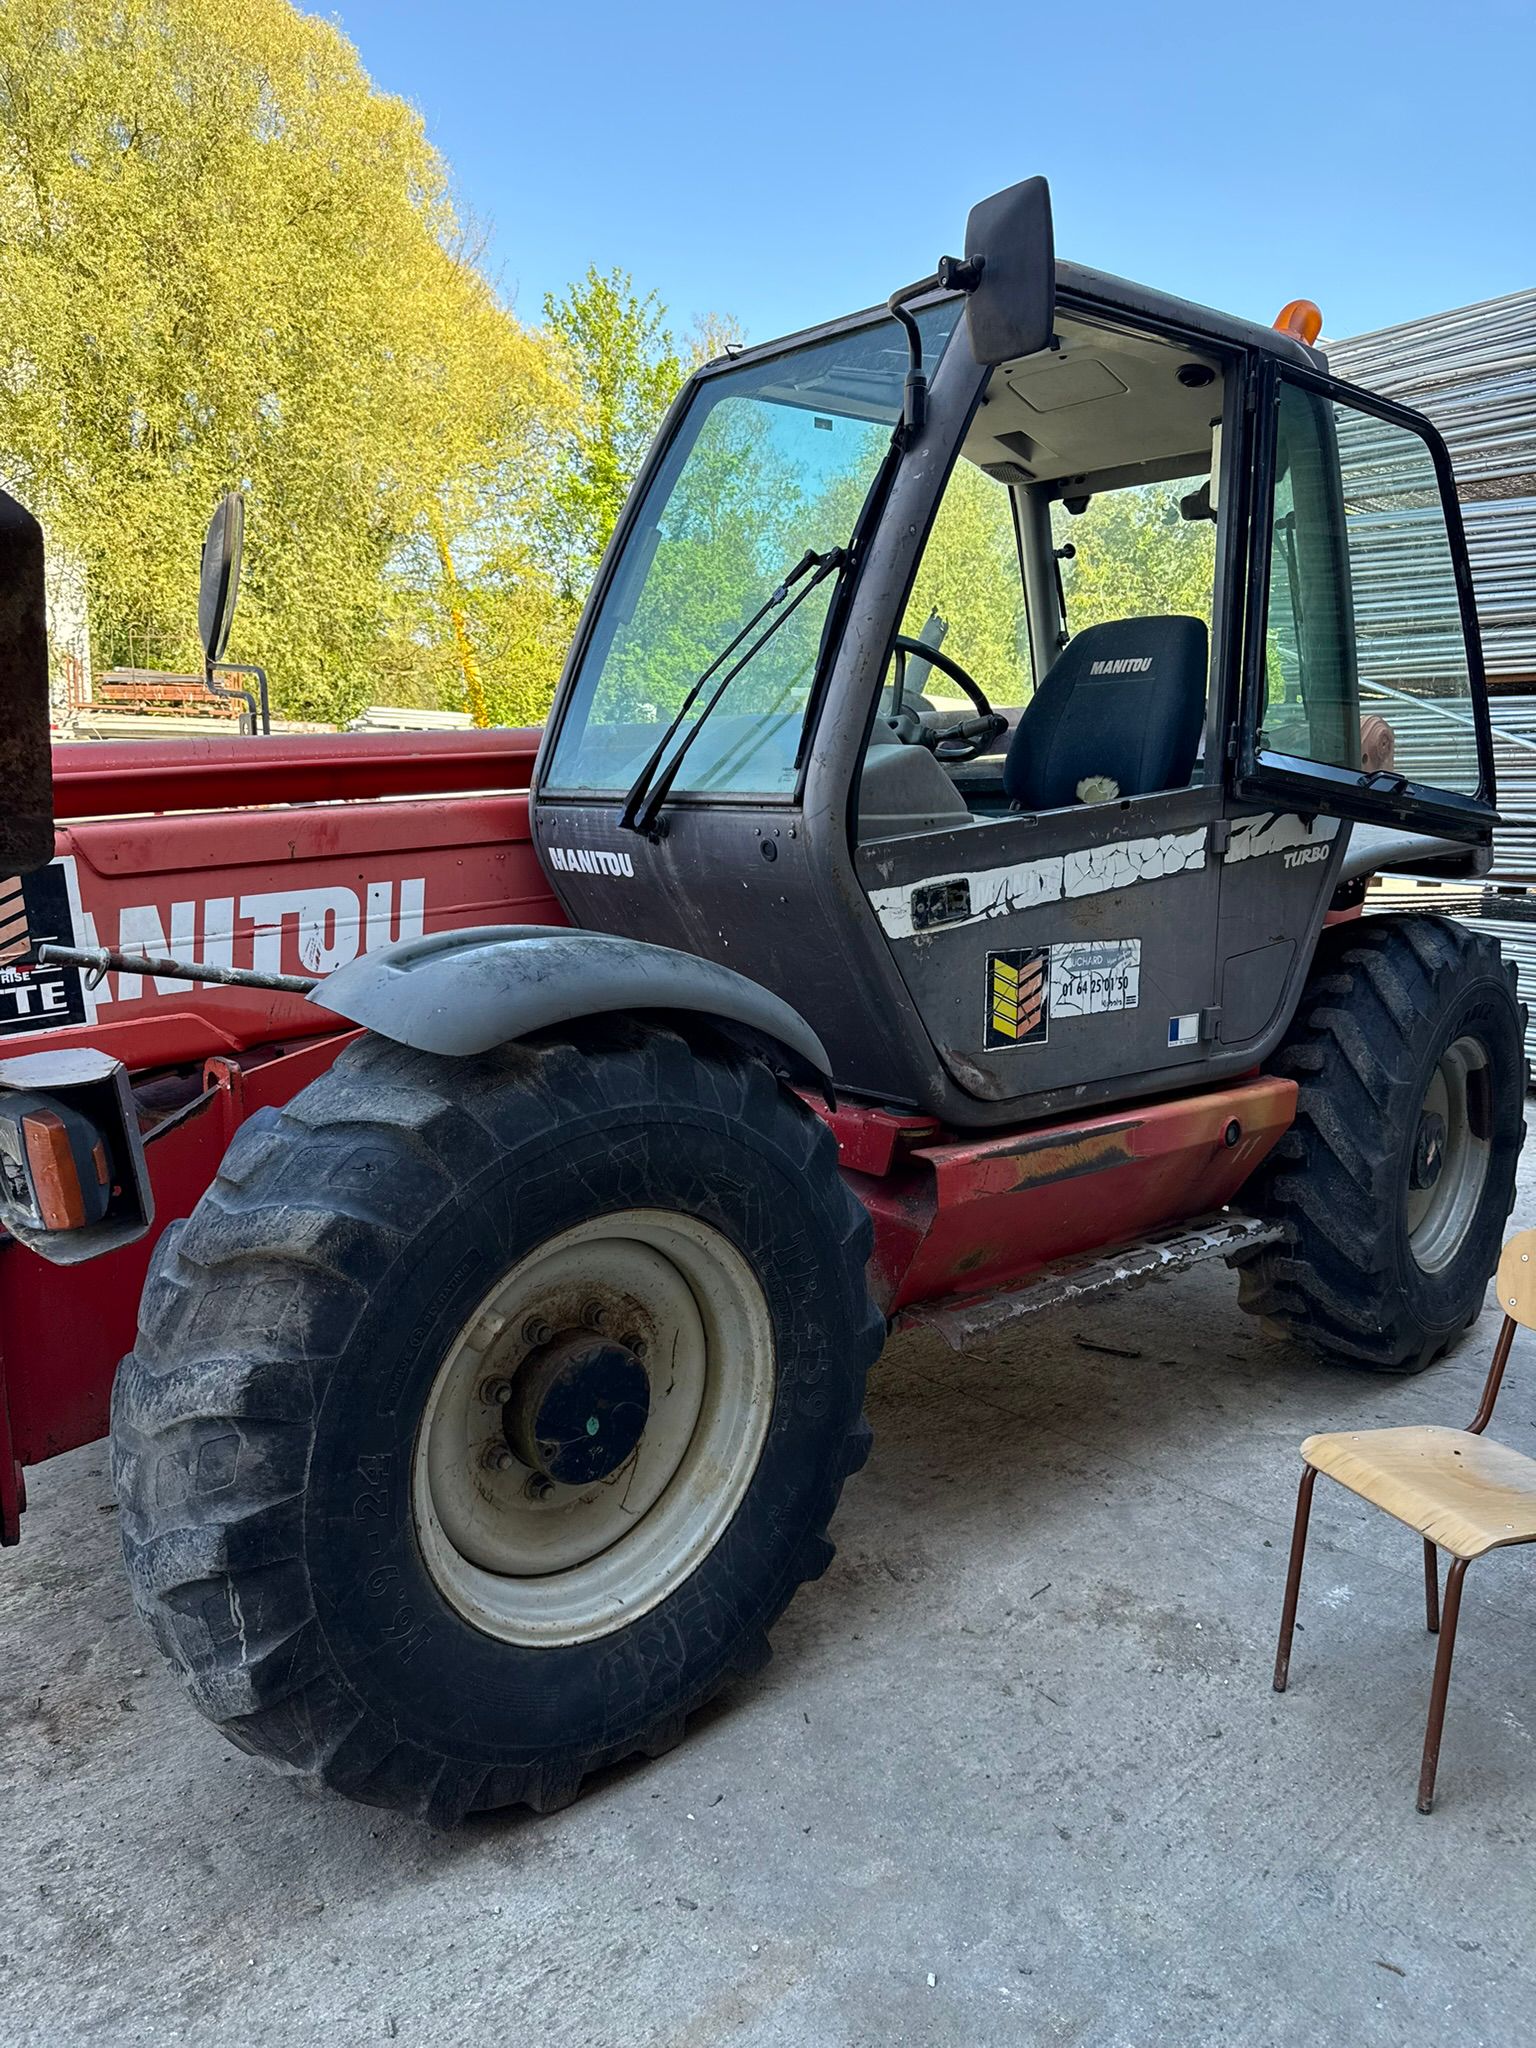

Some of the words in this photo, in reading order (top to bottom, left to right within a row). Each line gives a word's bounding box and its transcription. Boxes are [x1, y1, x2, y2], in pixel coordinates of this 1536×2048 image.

[1090, 657, 1153, 676] MANITOU
[548, 847, 635, 878] MANITOU
[1284, 844, 1330, 869] TURBO
[1062, 981, 1073, 997] 01
[1077, 980, 1088, 995] 64
[1091, 979, 1101, 993] 25
[1104, 978, 1114, 991] 01
